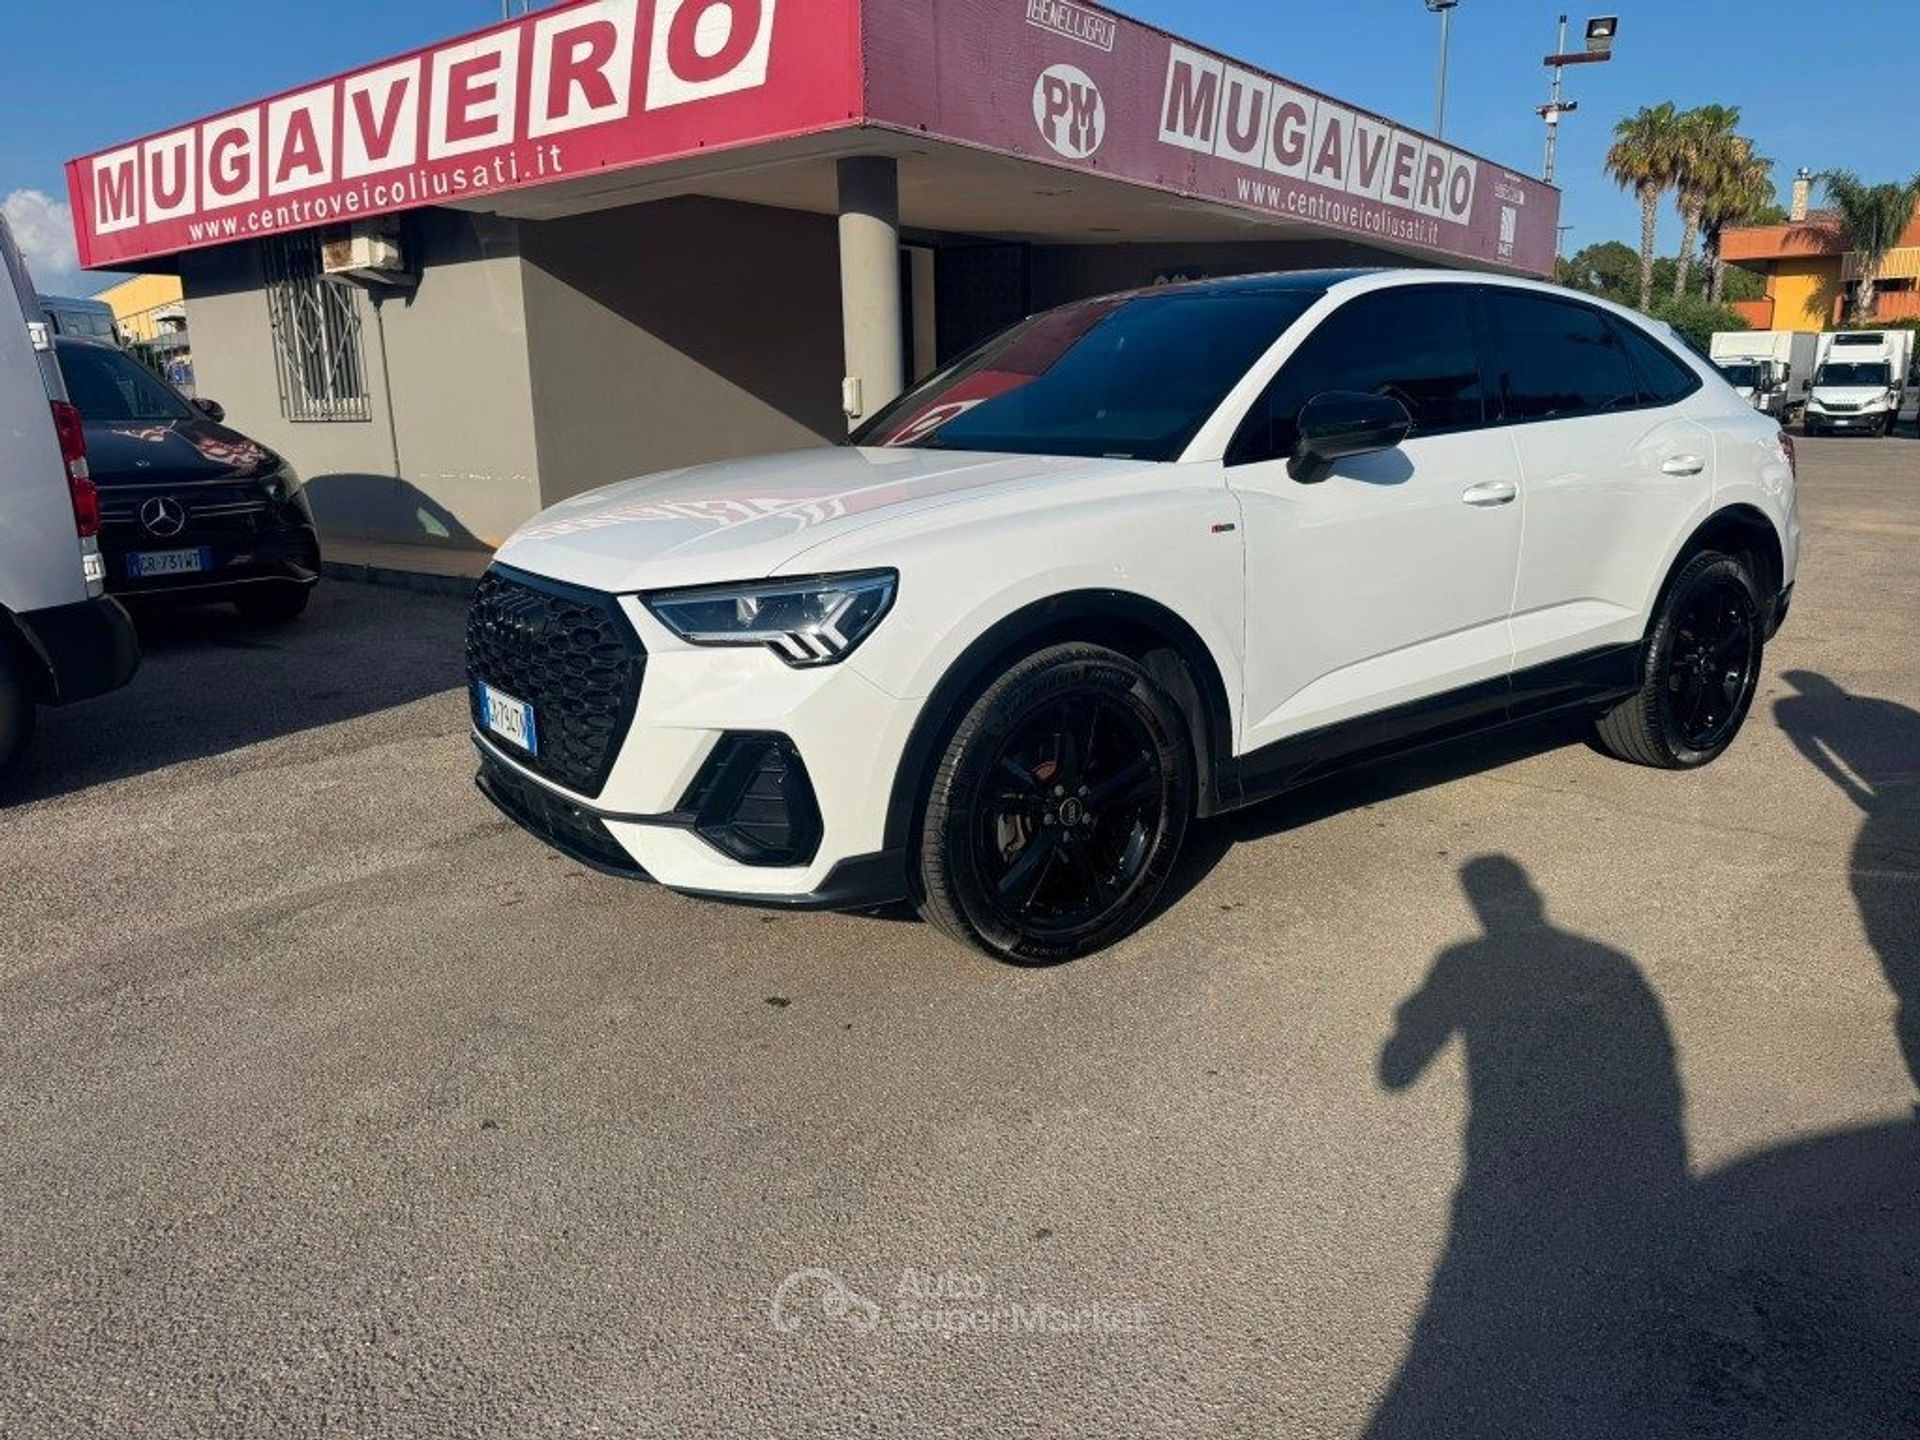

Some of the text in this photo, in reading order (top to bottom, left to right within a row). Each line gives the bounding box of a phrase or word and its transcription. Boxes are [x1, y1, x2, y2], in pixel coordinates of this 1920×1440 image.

[98, 0, 762, 222] MUGAVERO
[1042, 73, 1098, 152] PM
[1166, 62, 1472, 215] MUGAVERO
[189, 144, 562, 241] www.centroveicoliusati.it
[1237, 177, 1438, 244] www.centroveicoliusati.it
